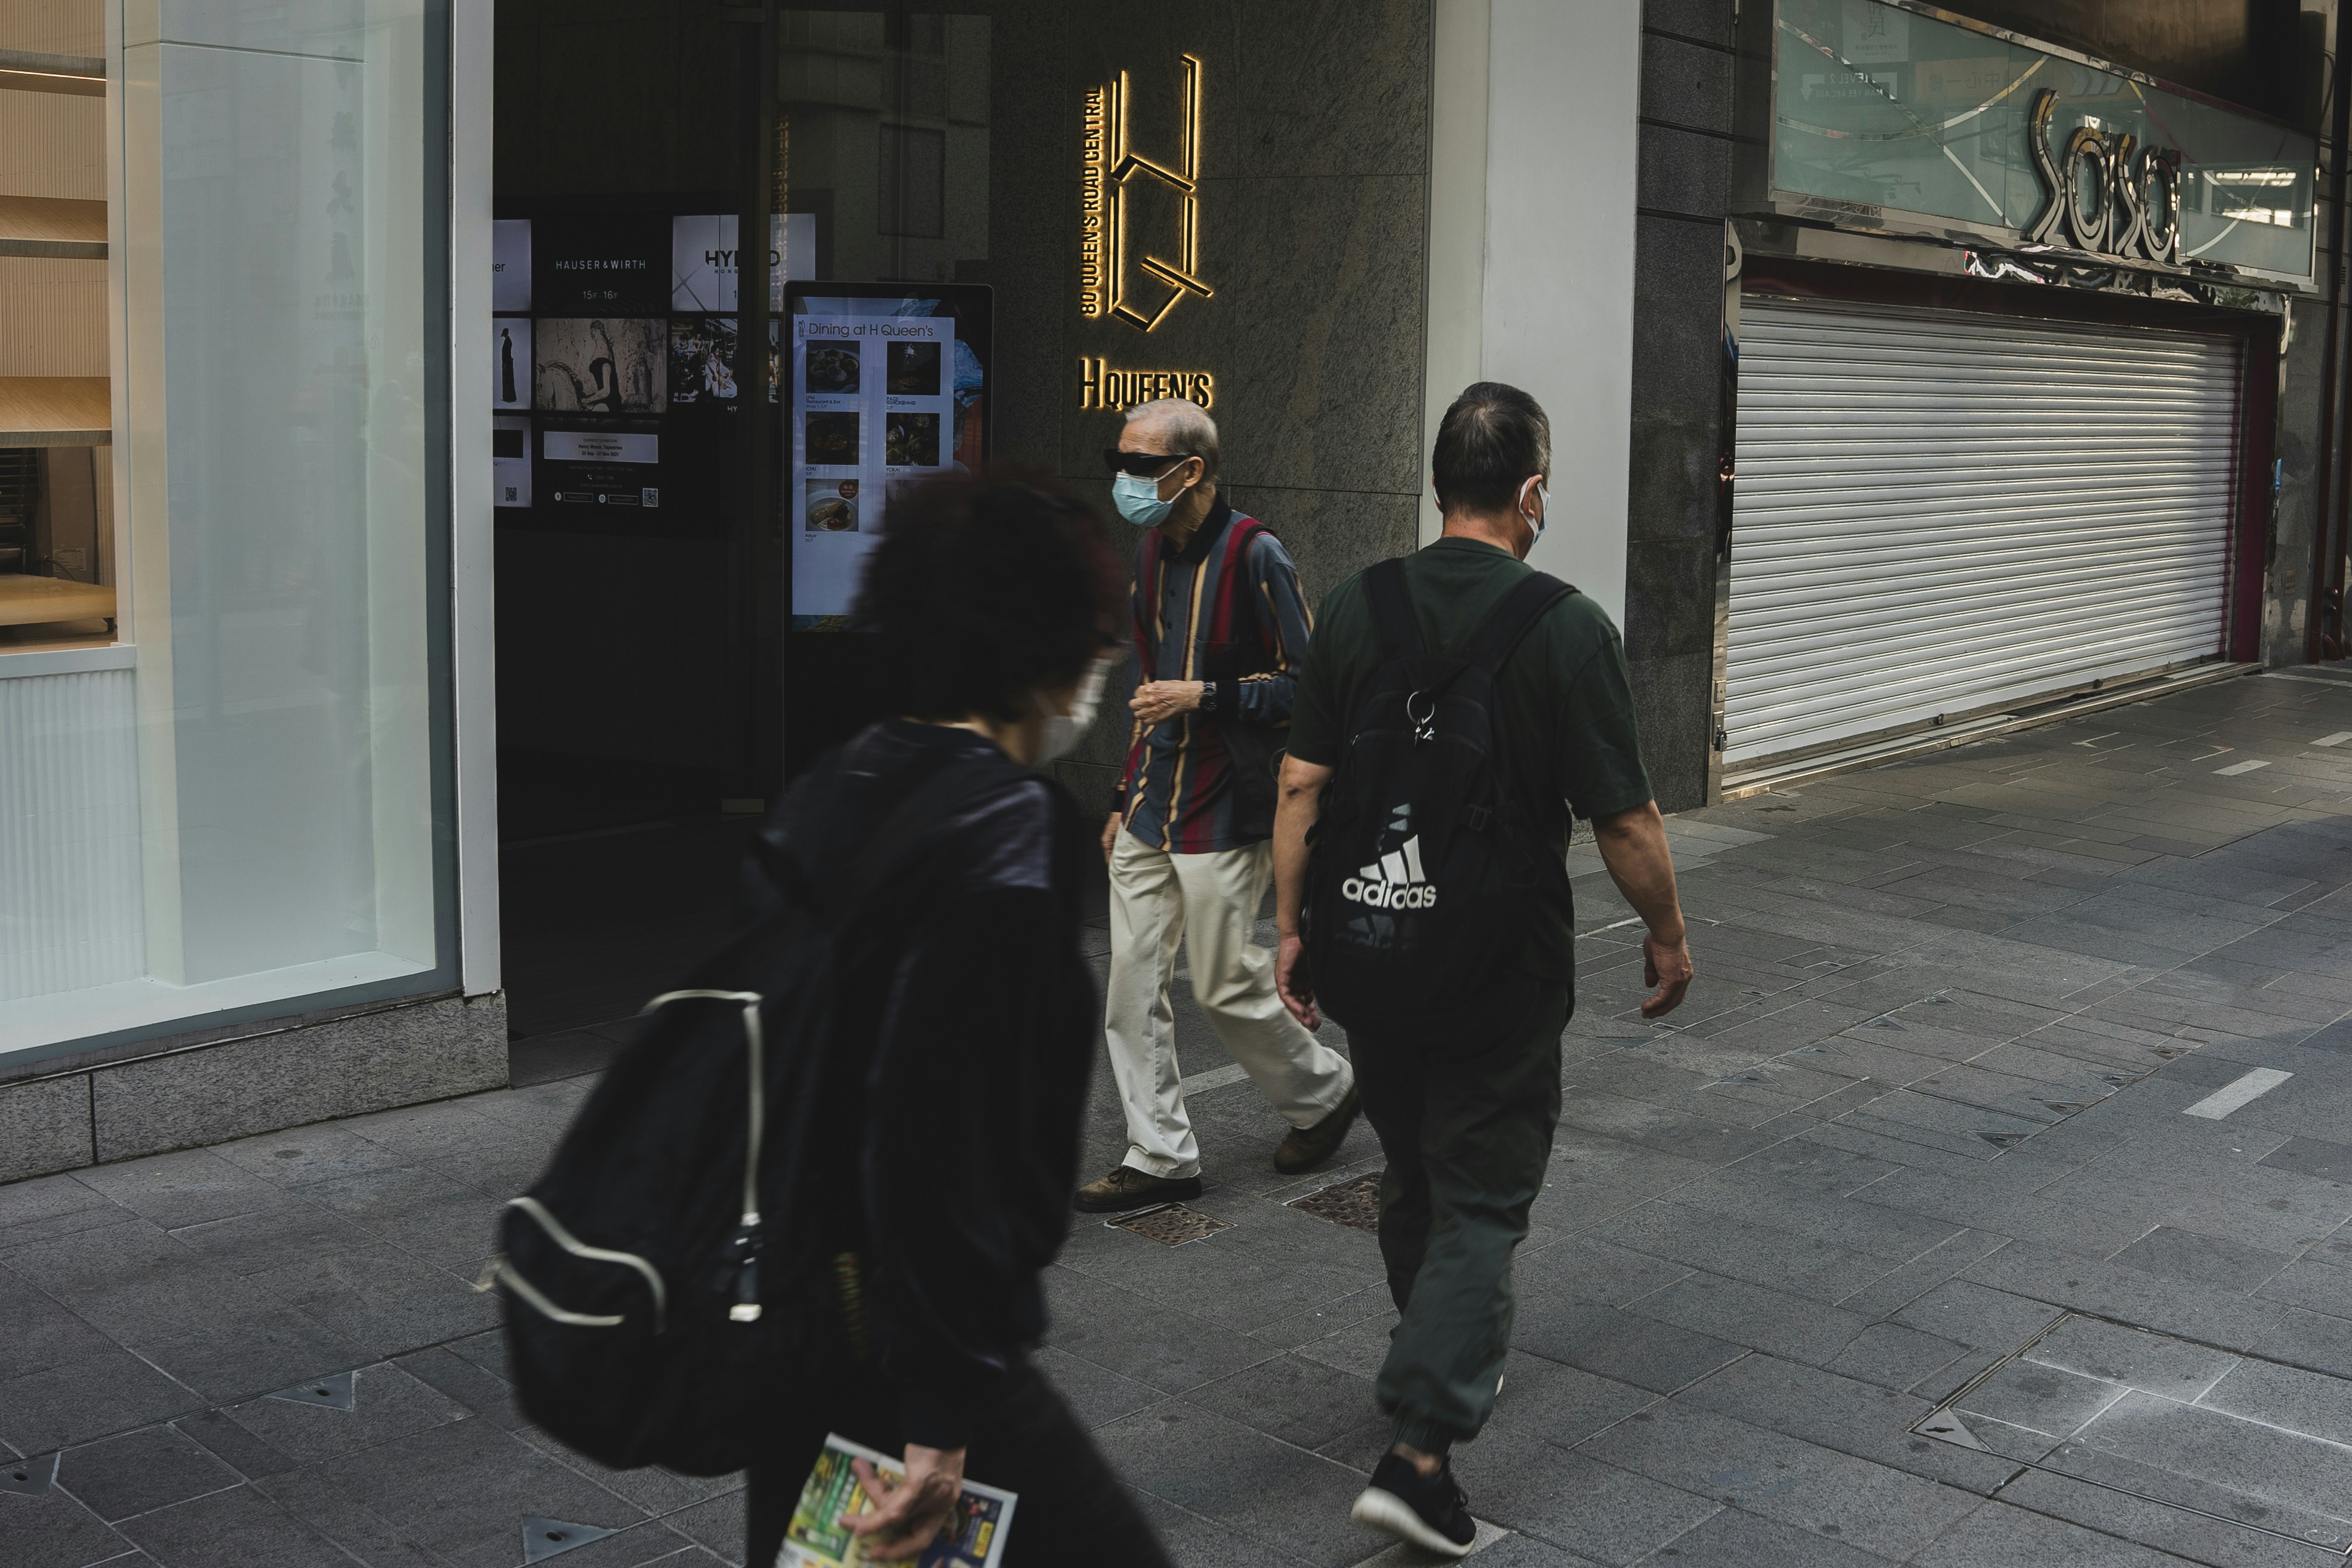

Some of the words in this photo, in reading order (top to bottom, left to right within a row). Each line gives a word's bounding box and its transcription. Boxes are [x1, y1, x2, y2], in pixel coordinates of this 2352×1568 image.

[1083, 85, 1104, 161] CENTRAL
[1082, 167, 1101, 212] ROAD
[1080, 215, 1101, 286] QUEEN'S
[583, 290, 598, 300] 15/F
[604, 290, 619, 300] 16/F
[1080, 289, 1097, 315] 80
[809, 323, 849, 337] Dining
[854, 324, 866, 335] at
[870, 324, 878, 335] H
[881, 324, 934, 336] Queen's
[1343, 877, 1437, 910] adidas
